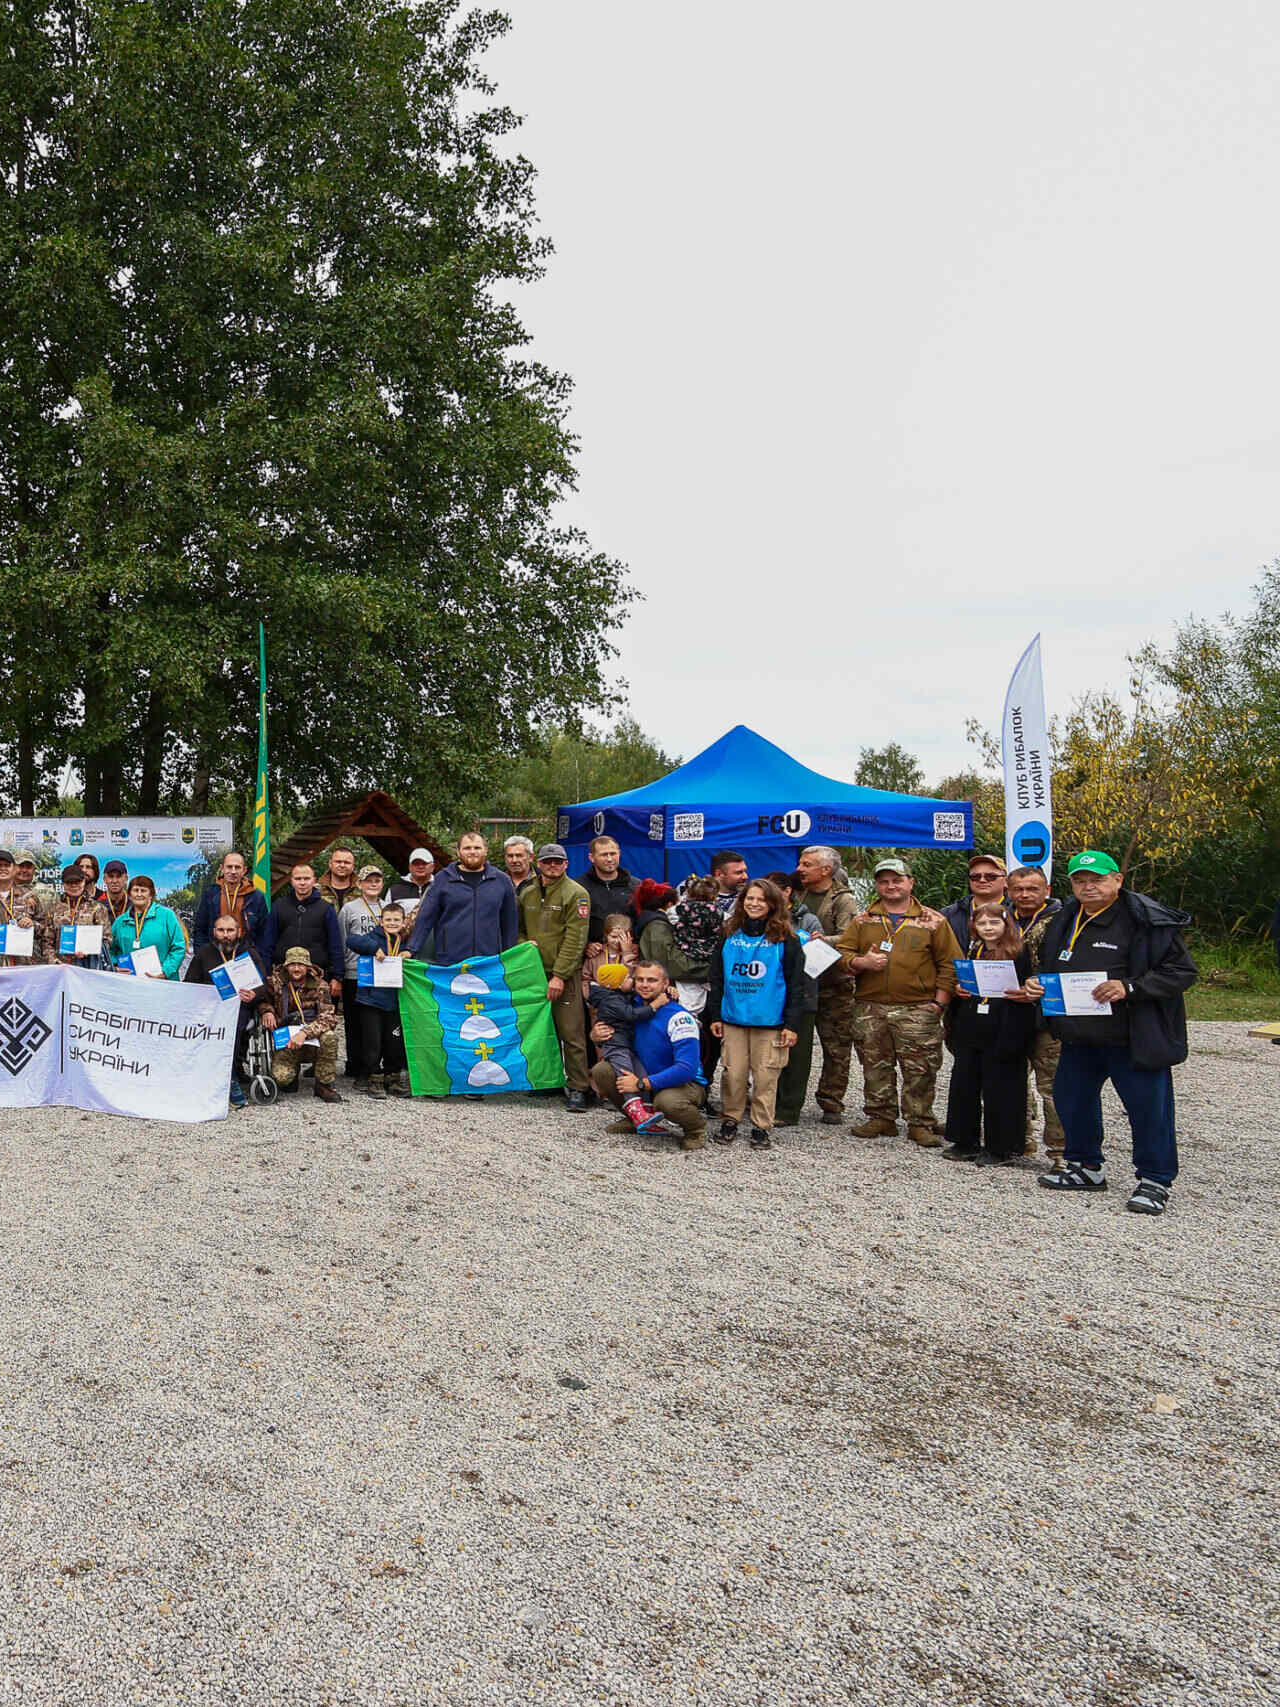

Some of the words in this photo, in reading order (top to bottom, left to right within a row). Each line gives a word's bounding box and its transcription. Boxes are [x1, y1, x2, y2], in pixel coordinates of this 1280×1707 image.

[1013, 706, 1028, 771] РИБАЛОК
[1016, 774, 1030, 809] КЛУБ
[1029, 749, 1045, 808] УКРАЇНИ
[757, 814, 801, 834] FCU
[731, 963, 760, 977] FCU
[69, 1046, 150, 1077] УКРАЇНИ
